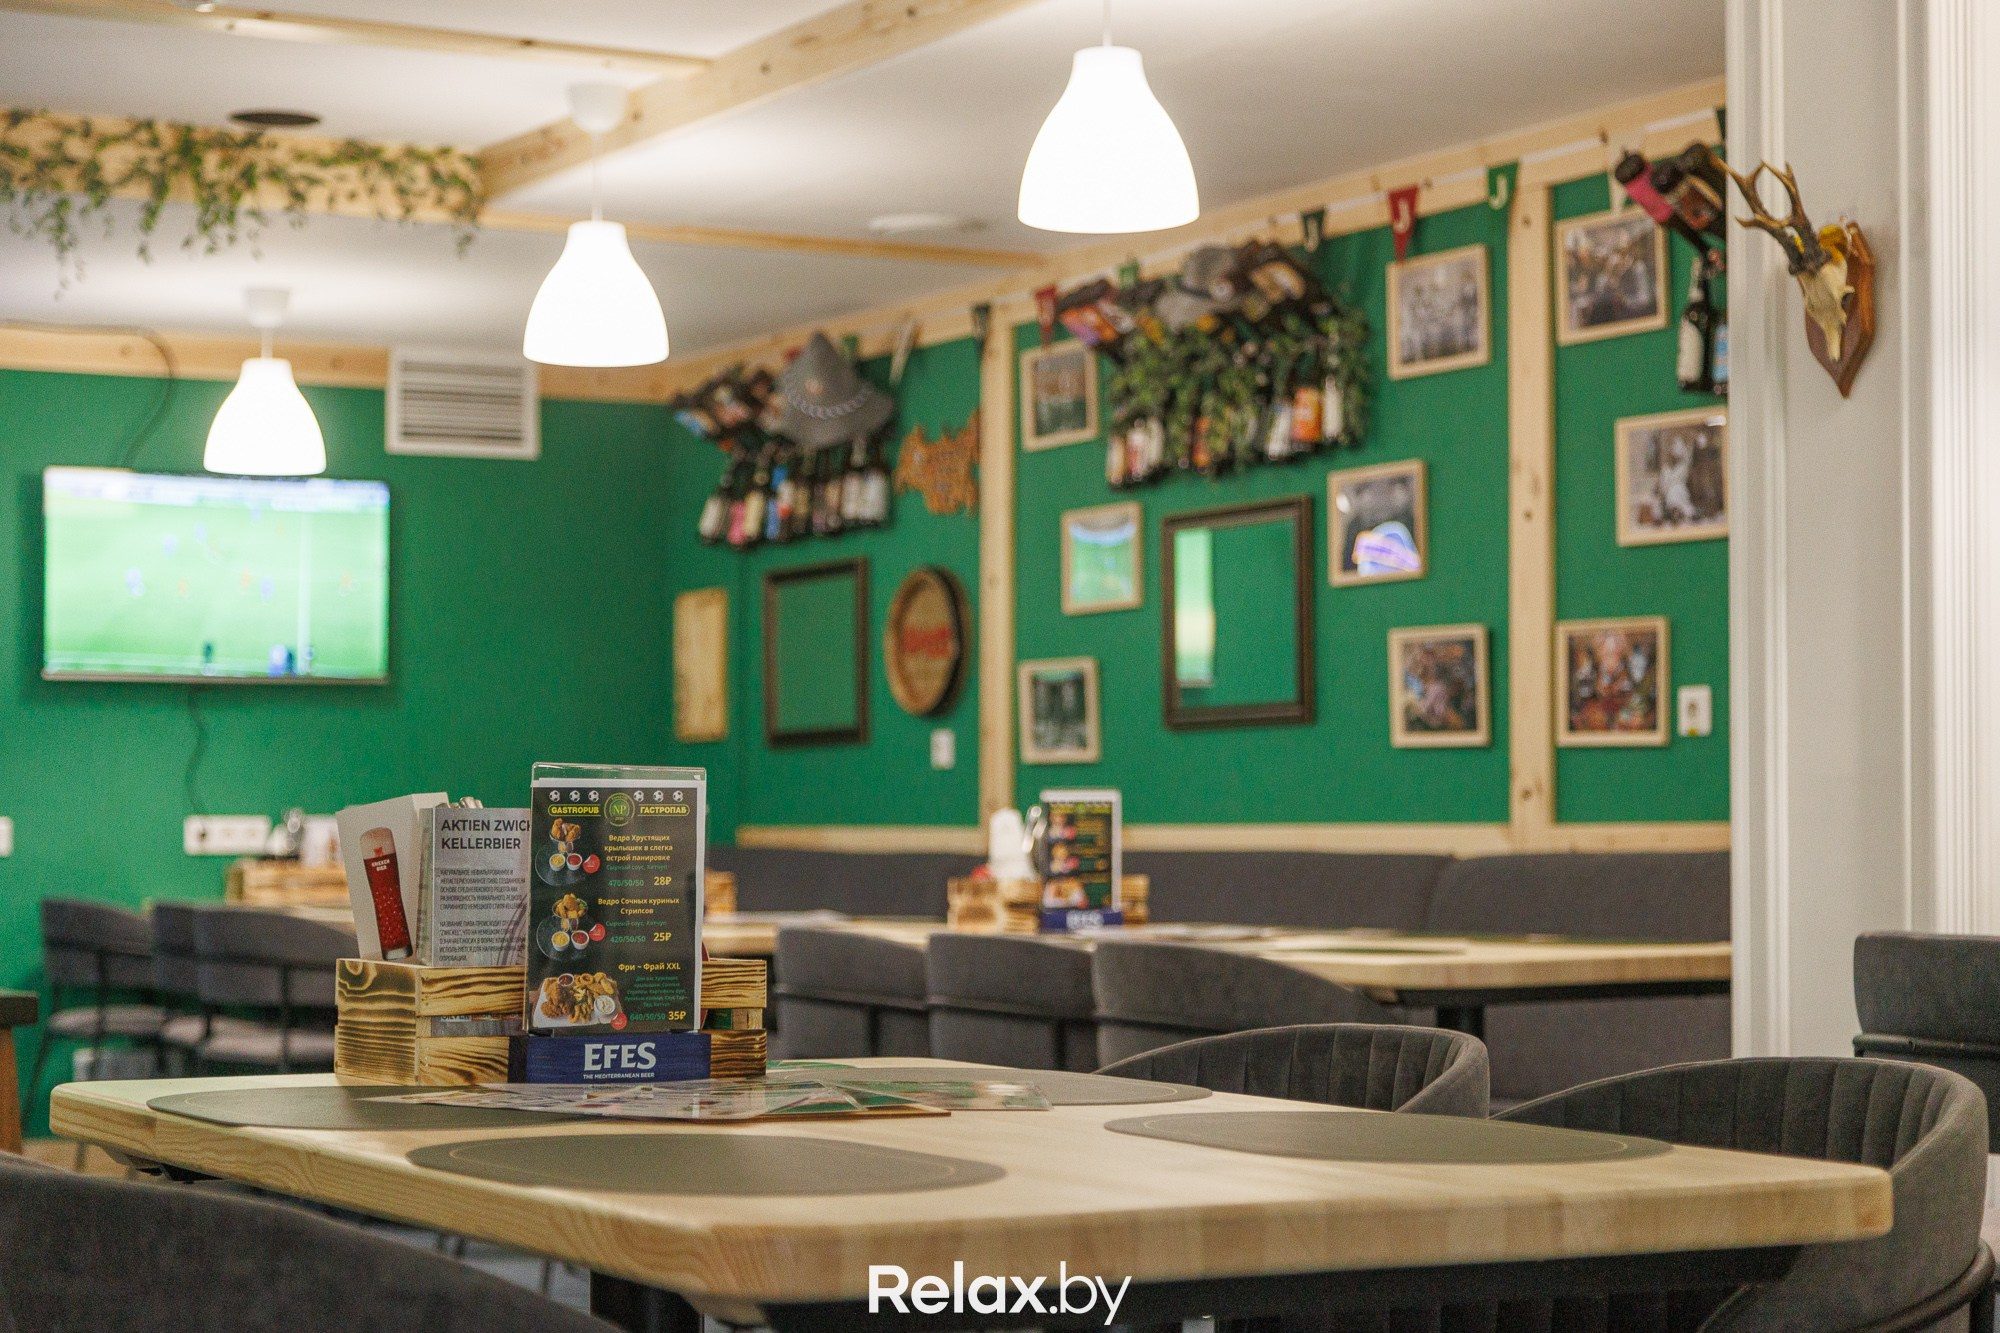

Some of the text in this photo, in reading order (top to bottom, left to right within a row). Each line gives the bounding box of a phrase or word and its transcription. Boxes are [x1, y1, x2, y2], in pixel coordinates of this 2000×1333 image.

[640, 806, 687, 814] ГАСТРОПАБ
[441, 820, 490, 831] AKTIEN
[608, 834, 670, 842] Ведро Хрустящих
[441, 838, 521, 850] KELLERBIER
[606, 854, 631, 862] острой
[598, 898, 620, 906] Ведро
[618, 963, 636, 972] Фри
[643, 962, 665, 972] Фрай
[584, 1042, 656, 1071] EFES
